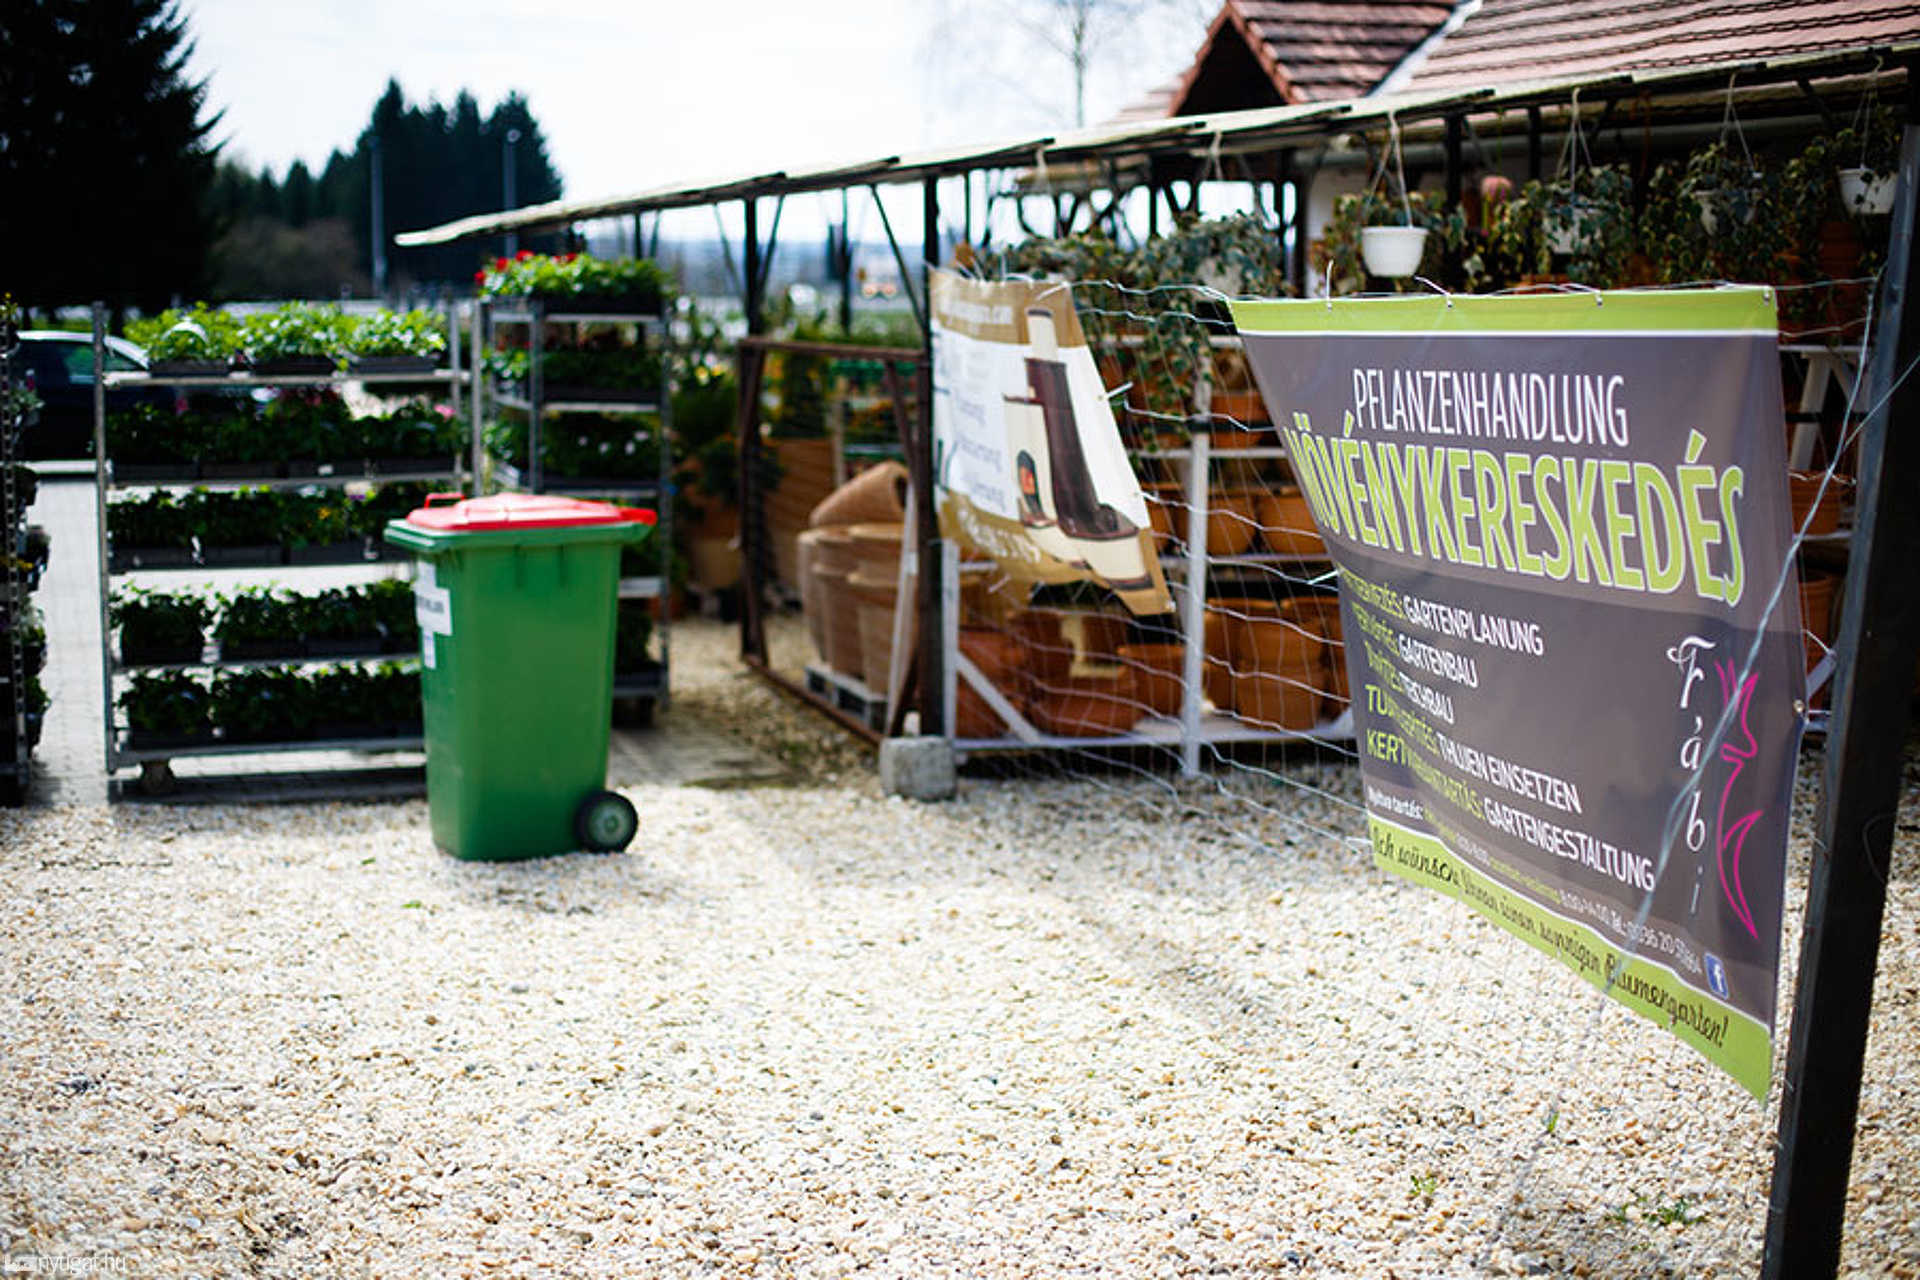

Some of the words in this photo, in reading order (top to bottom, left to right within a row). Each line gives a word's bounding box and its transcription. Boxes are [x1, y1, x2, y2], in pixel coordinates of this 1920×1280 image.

[1352, 368, 1629, 447] PFLANZENHANDLUNG
[1403, 595, 1544, 656] GARTENPLANUNG
[1398, 633, 1479, 689] GARTENBAU
[1487, 755, 1582, 815] EINSETZEN
[1484, 797, 1656, 892] GARTENGESTALTUNG
